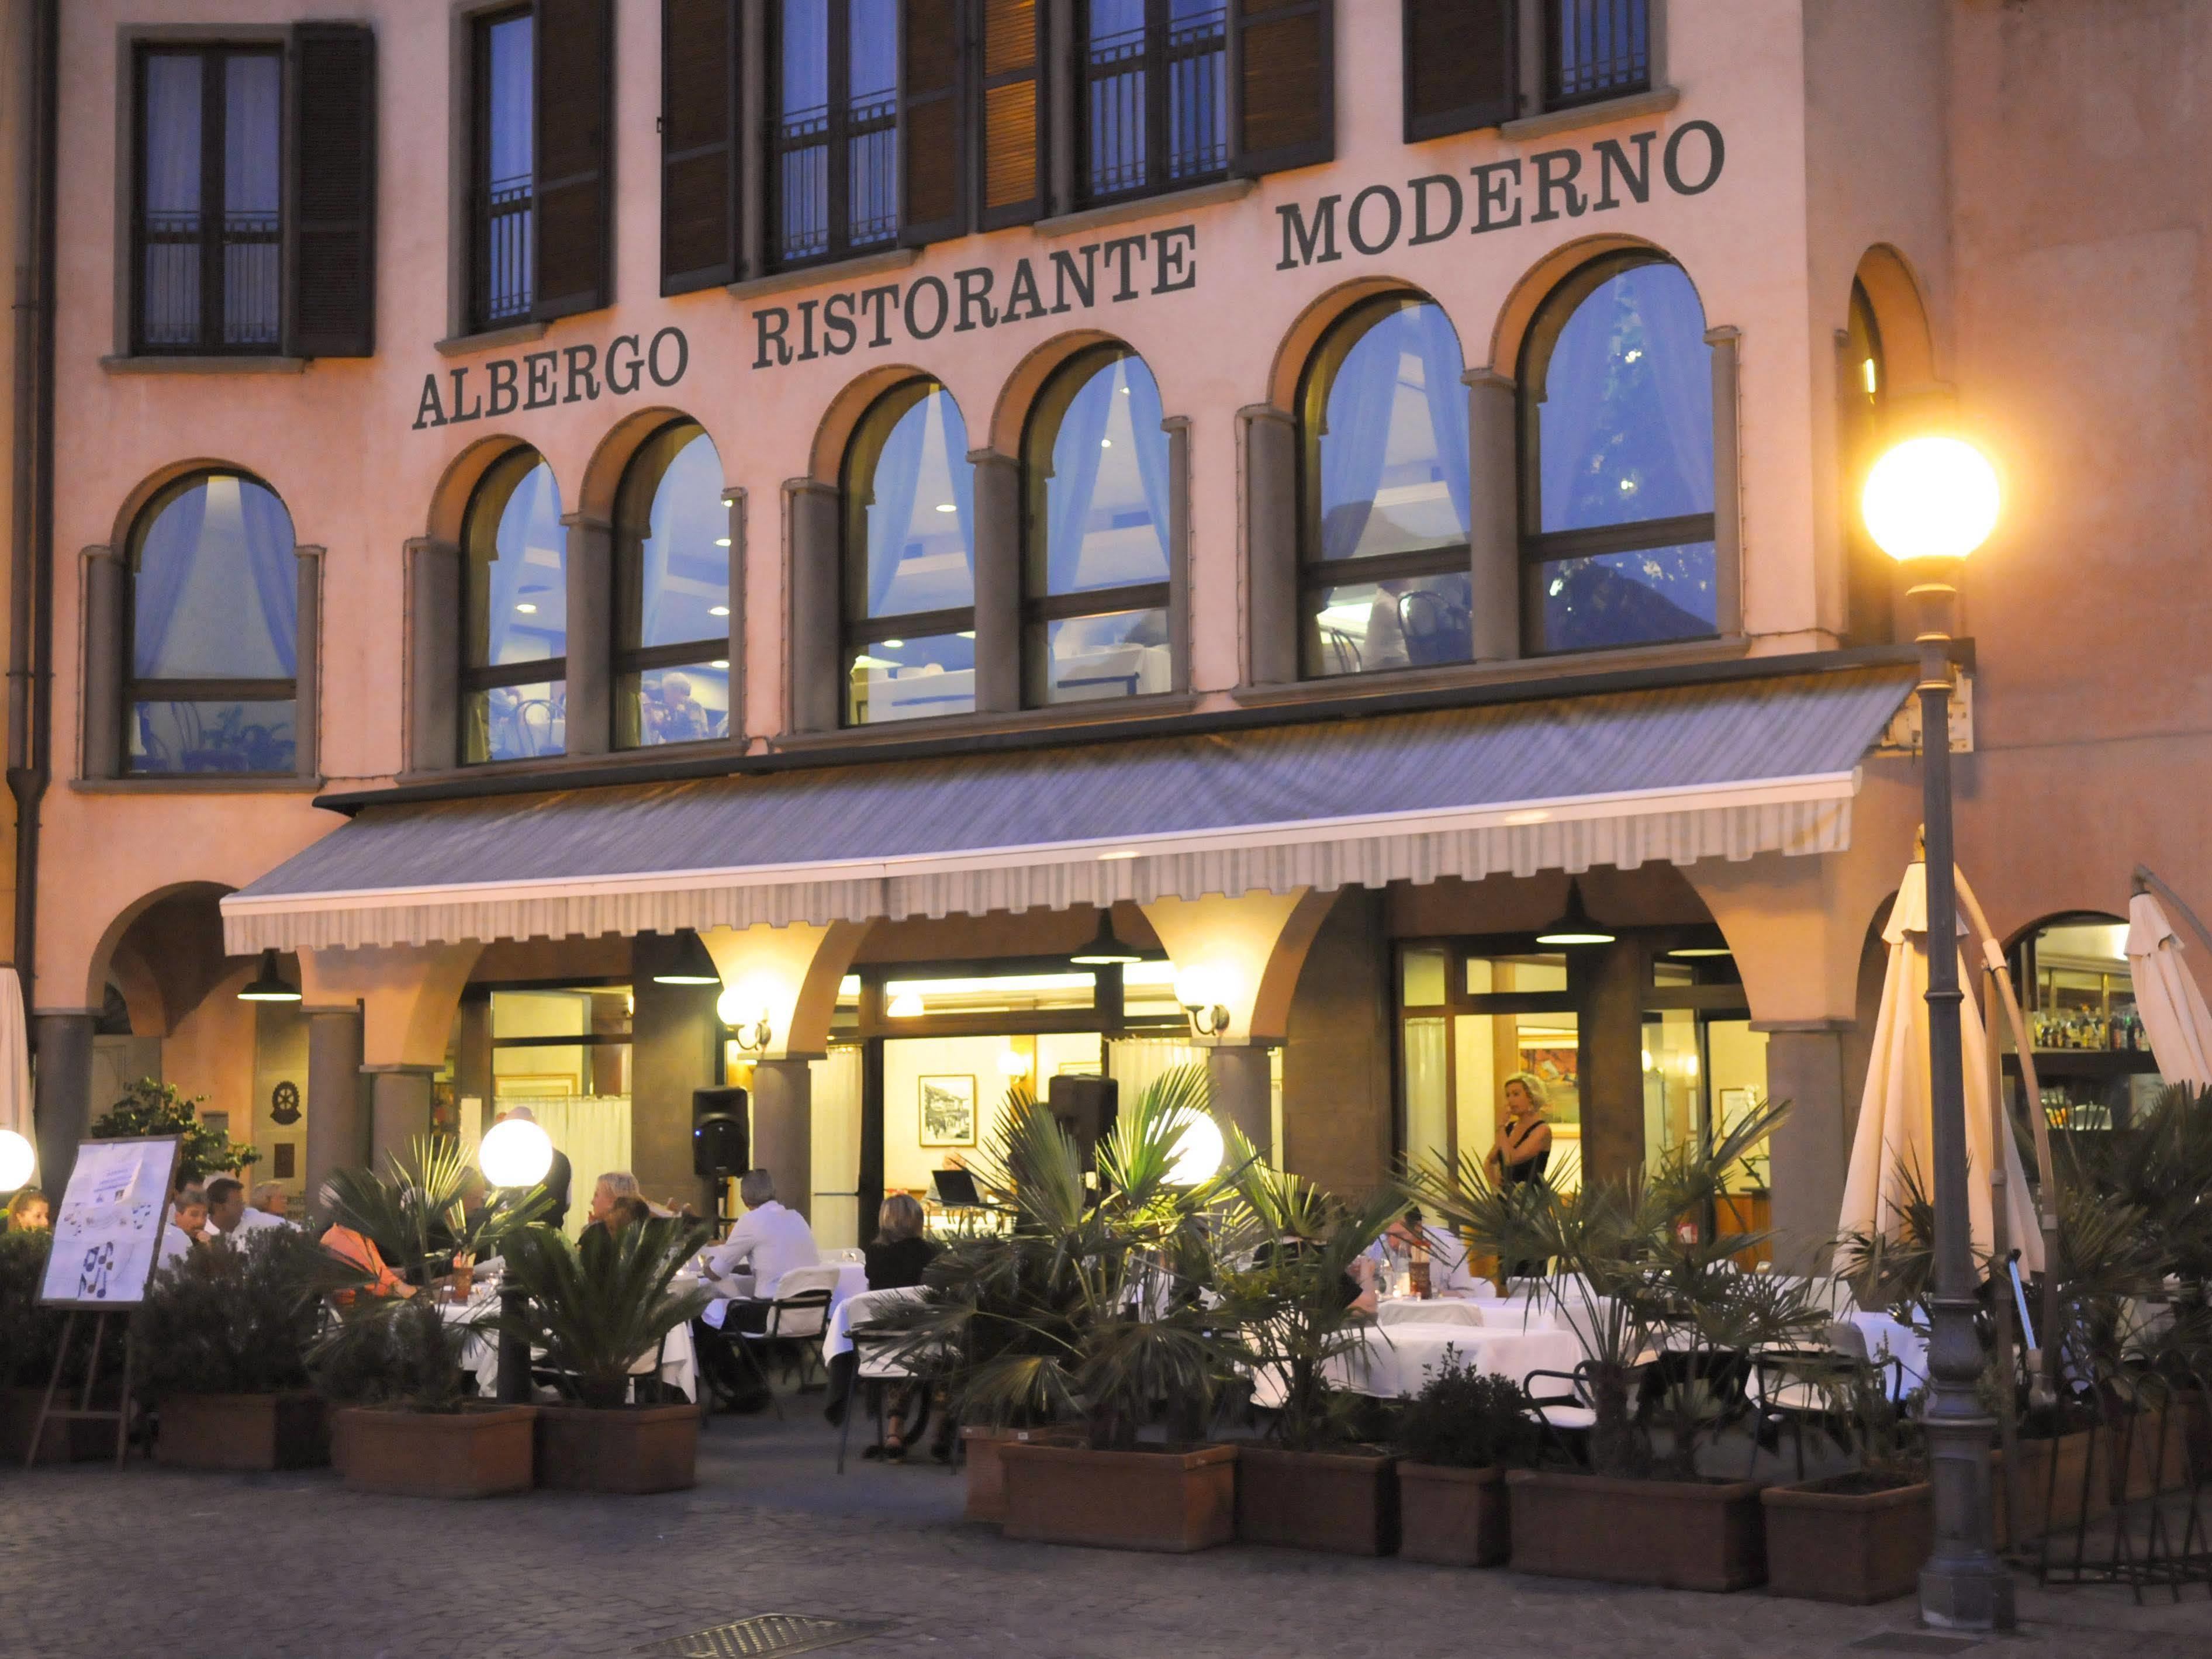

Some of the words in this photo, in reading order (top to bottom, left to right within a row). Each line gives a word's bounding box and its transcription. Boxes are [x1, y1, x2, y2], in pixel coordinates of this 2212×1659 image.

[412, 327, 689, 430] ALBERGO
[752, 224, 1195, 369] RISTORANTE
[1276, 119, 1725, 271] MODERNO
